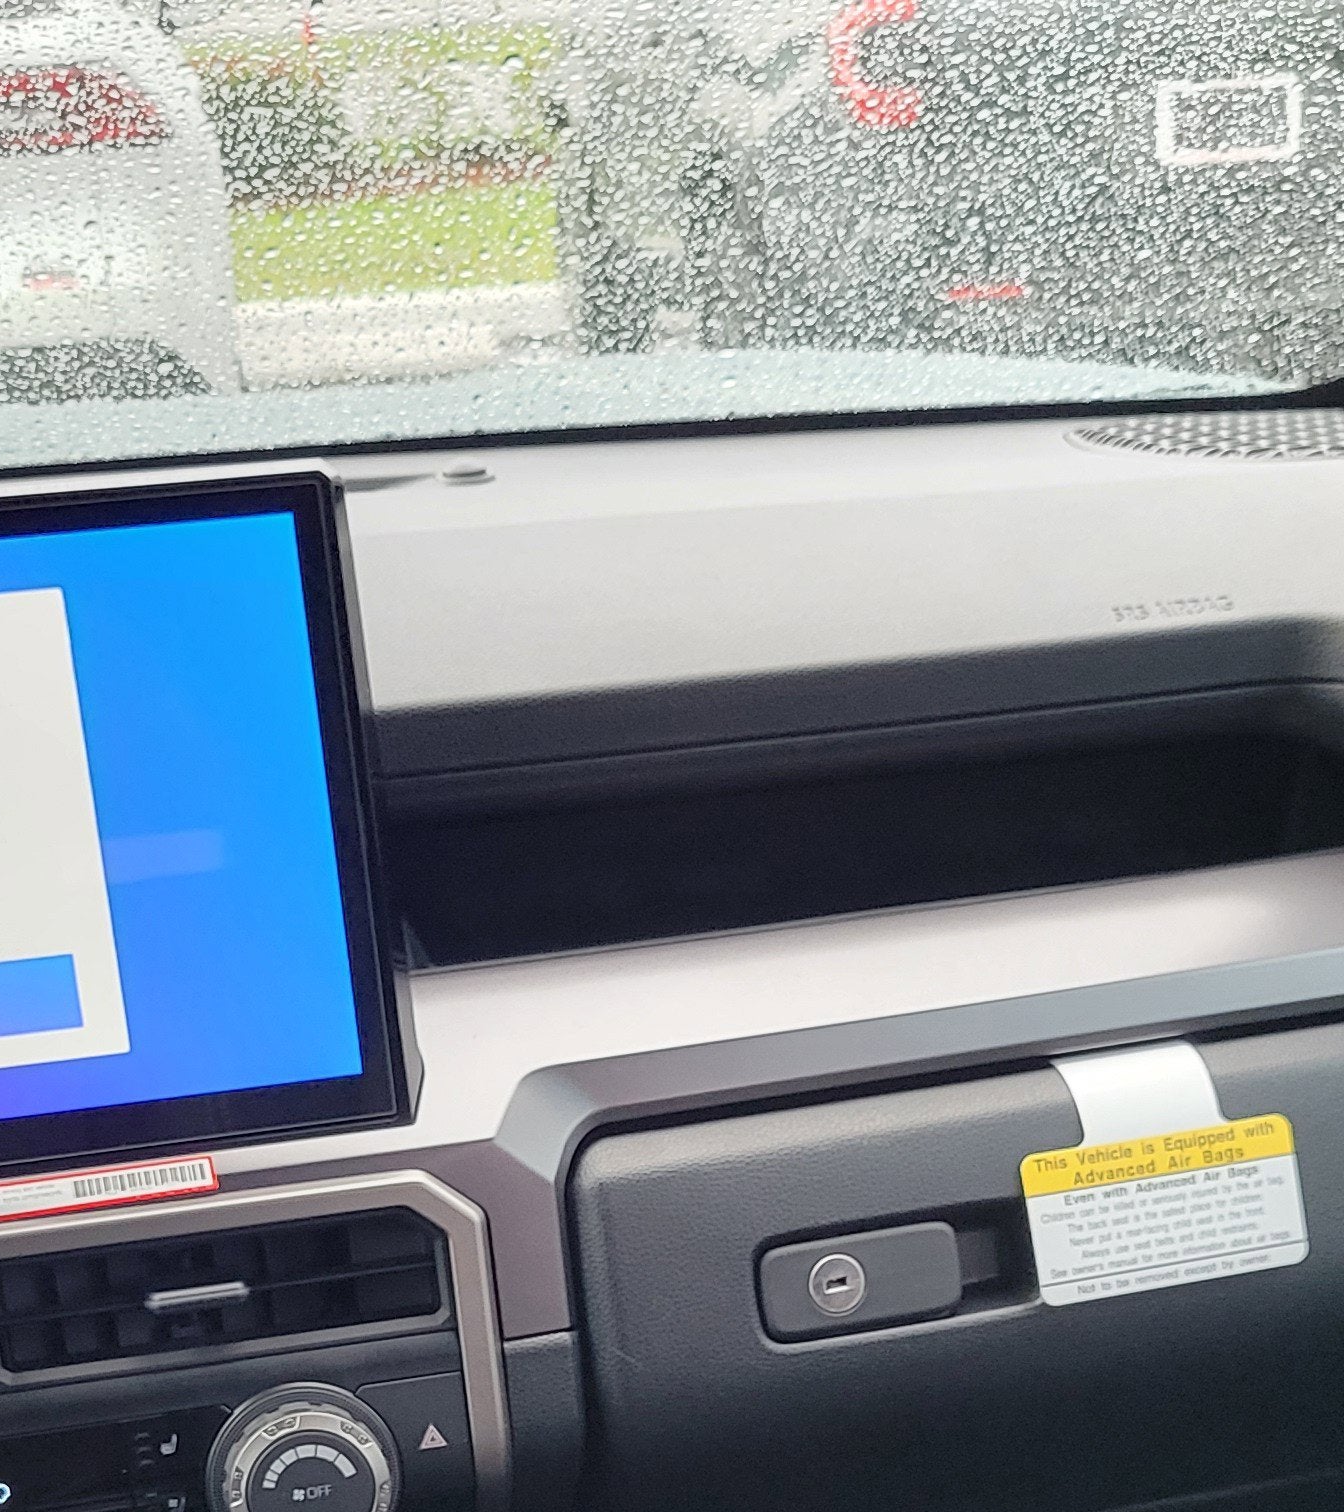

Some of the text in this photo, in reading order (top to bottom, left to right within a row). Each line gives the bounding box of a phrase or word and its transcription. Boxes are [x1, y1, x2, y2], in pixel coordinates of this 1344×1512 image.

[1033, 1121, 1275, 1173] This Vehicle is Equipped with
[1073, 1147, 1245, 1186] Advanced Air Bags
[1064, 1165, 1259, 1207] Even with Advanced Air Bags
[306, 1484, 333, 1500] OFF
